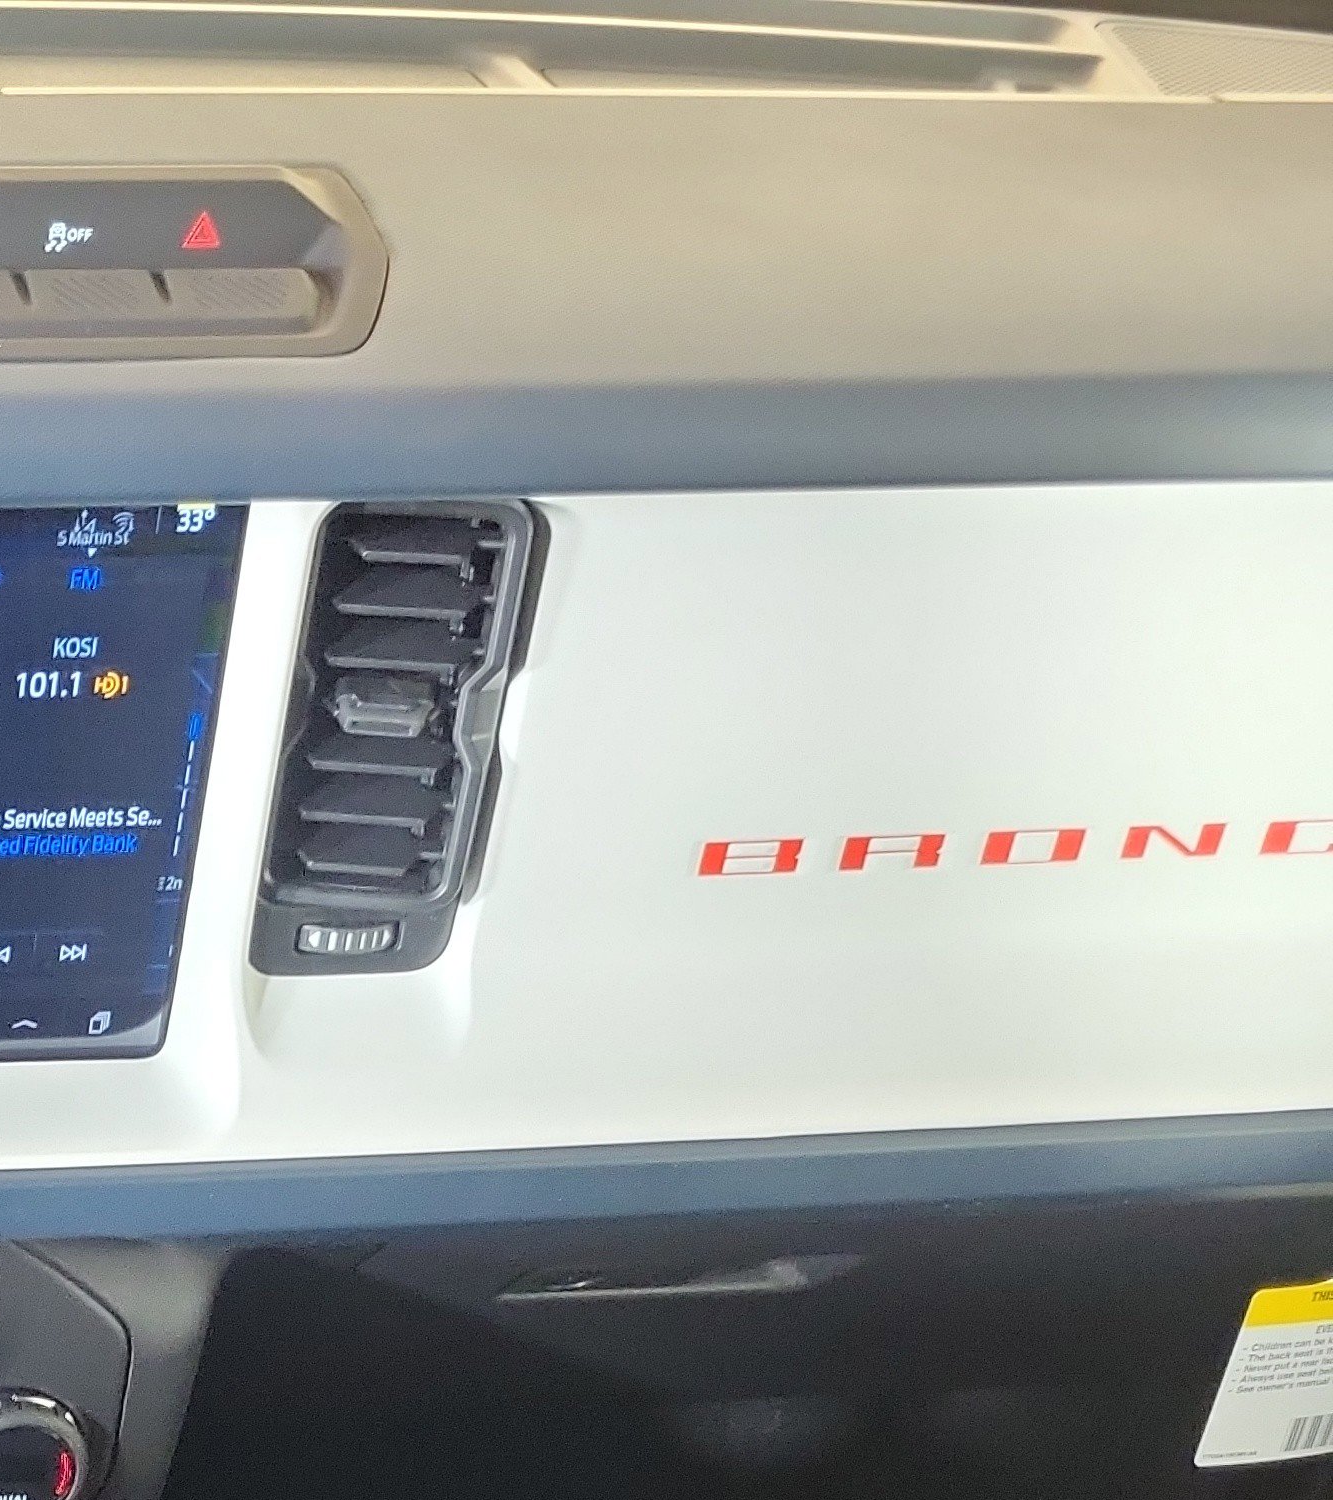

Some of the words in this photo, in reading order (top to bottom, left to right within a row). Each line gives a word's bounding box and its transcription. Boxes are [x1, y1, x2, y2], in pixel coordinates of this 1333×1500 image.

[67, 227, 94, 242] OFF
[70, 566, 101, 590] FM
[52, 636, 99, 660] KOSI
[16, 671, 81, 700] 101.1
[3, 808, 67, 830] Service
[68, 807, 124, 829] Meets
[24, 834, 90, 858] Fidelity
[91, 833, 138, 855] Bank
